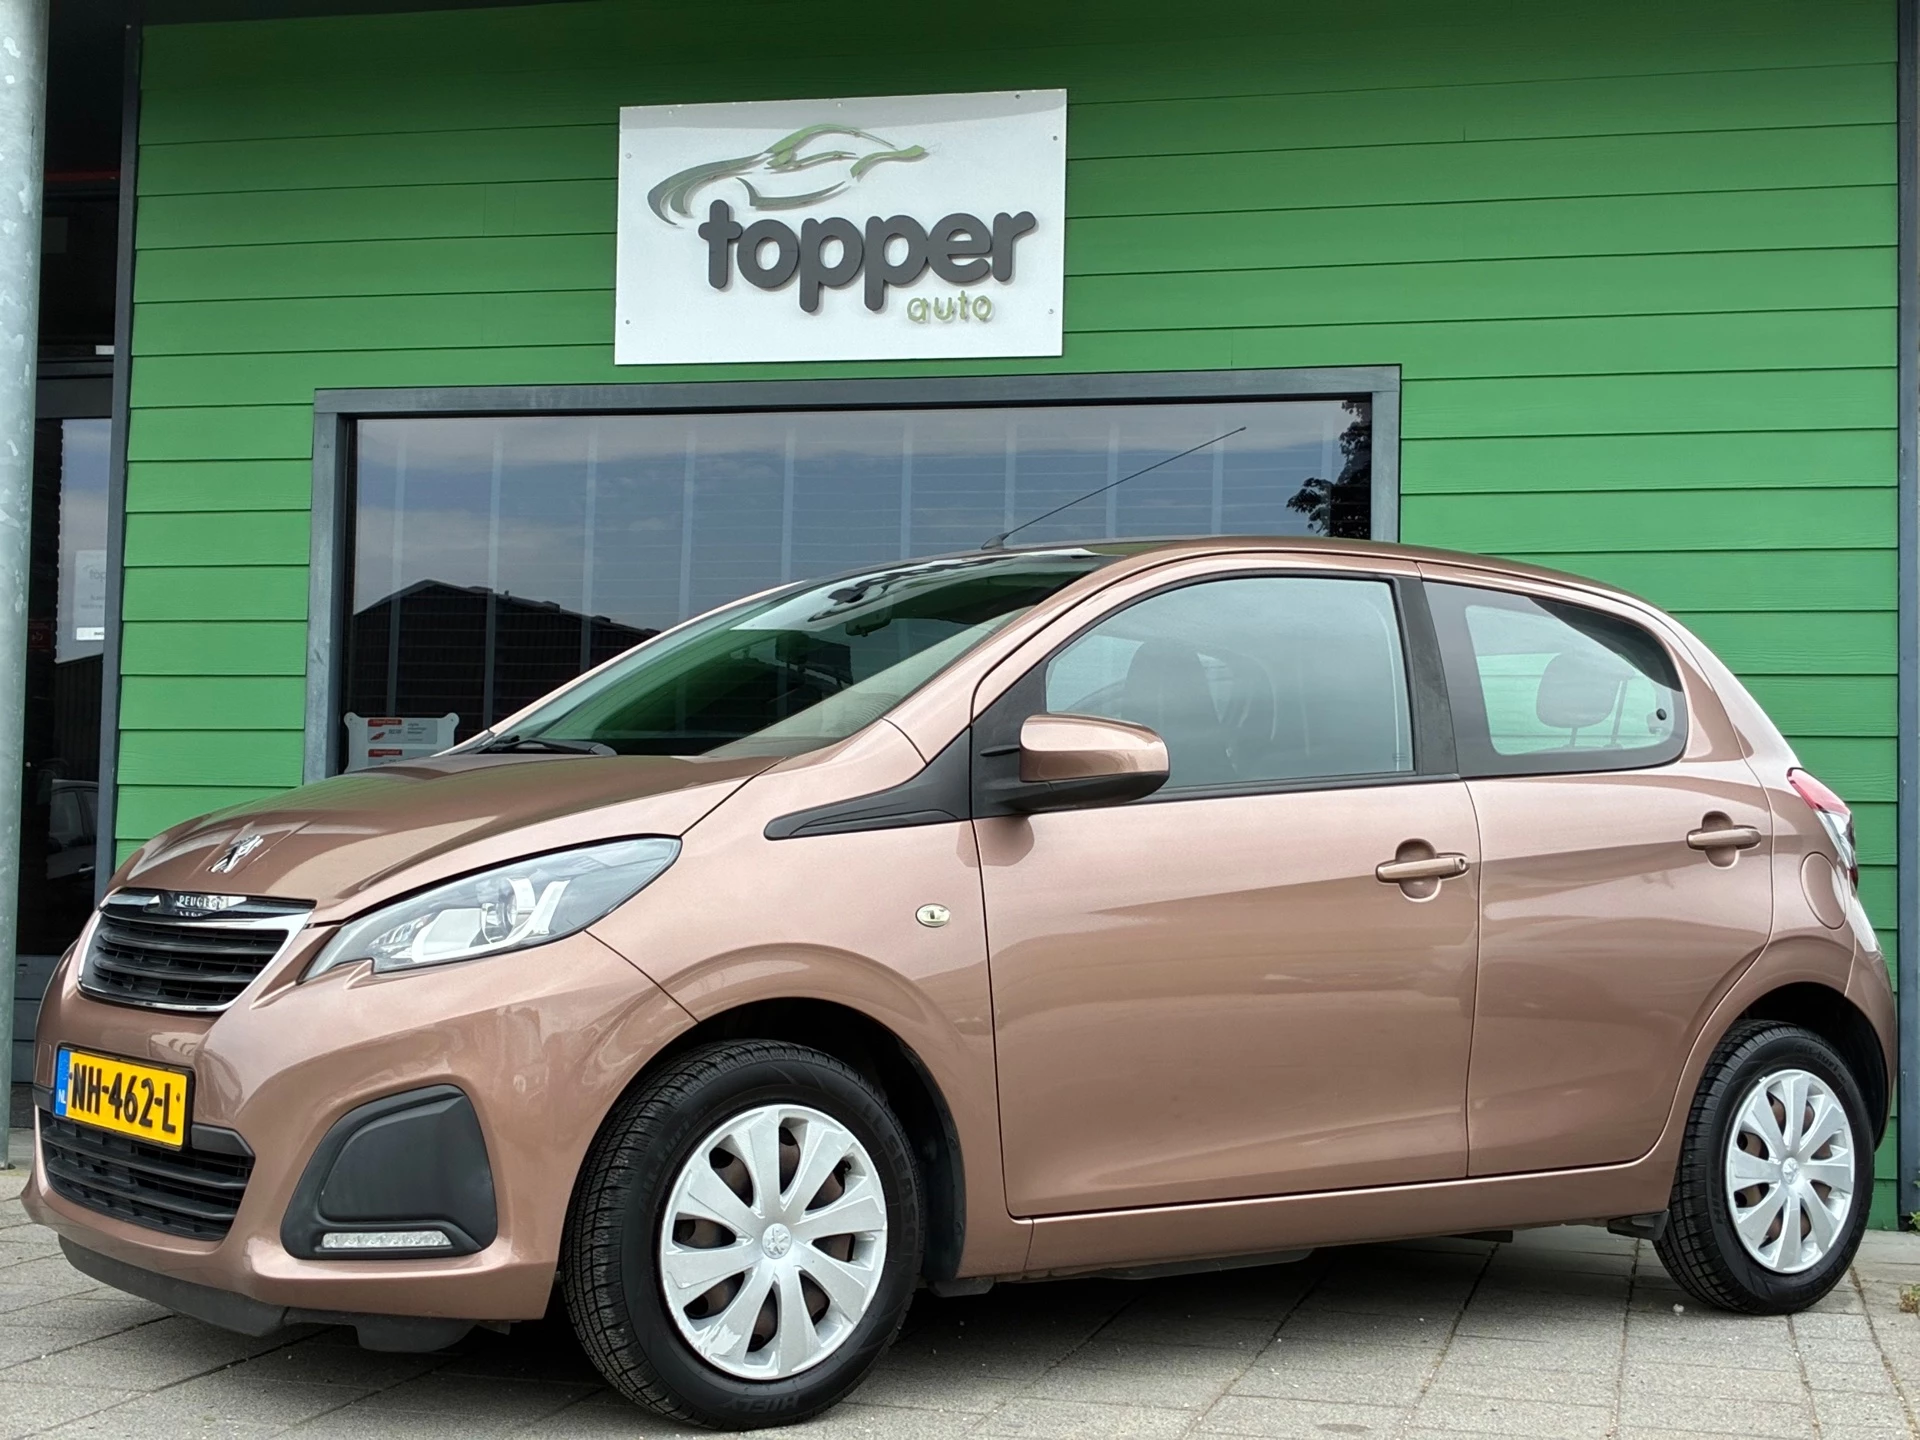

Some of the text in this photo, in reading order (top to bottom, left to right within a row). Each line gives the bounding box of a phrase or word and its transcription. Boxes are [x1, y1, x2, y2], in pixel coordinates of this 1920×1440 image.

[698, 199, 1037, 313] topper
[907, 290, 993, 323] auto
[57, 1089, 67, 1104] NL
[71, 1062, 177, 1134] NH-462-L
